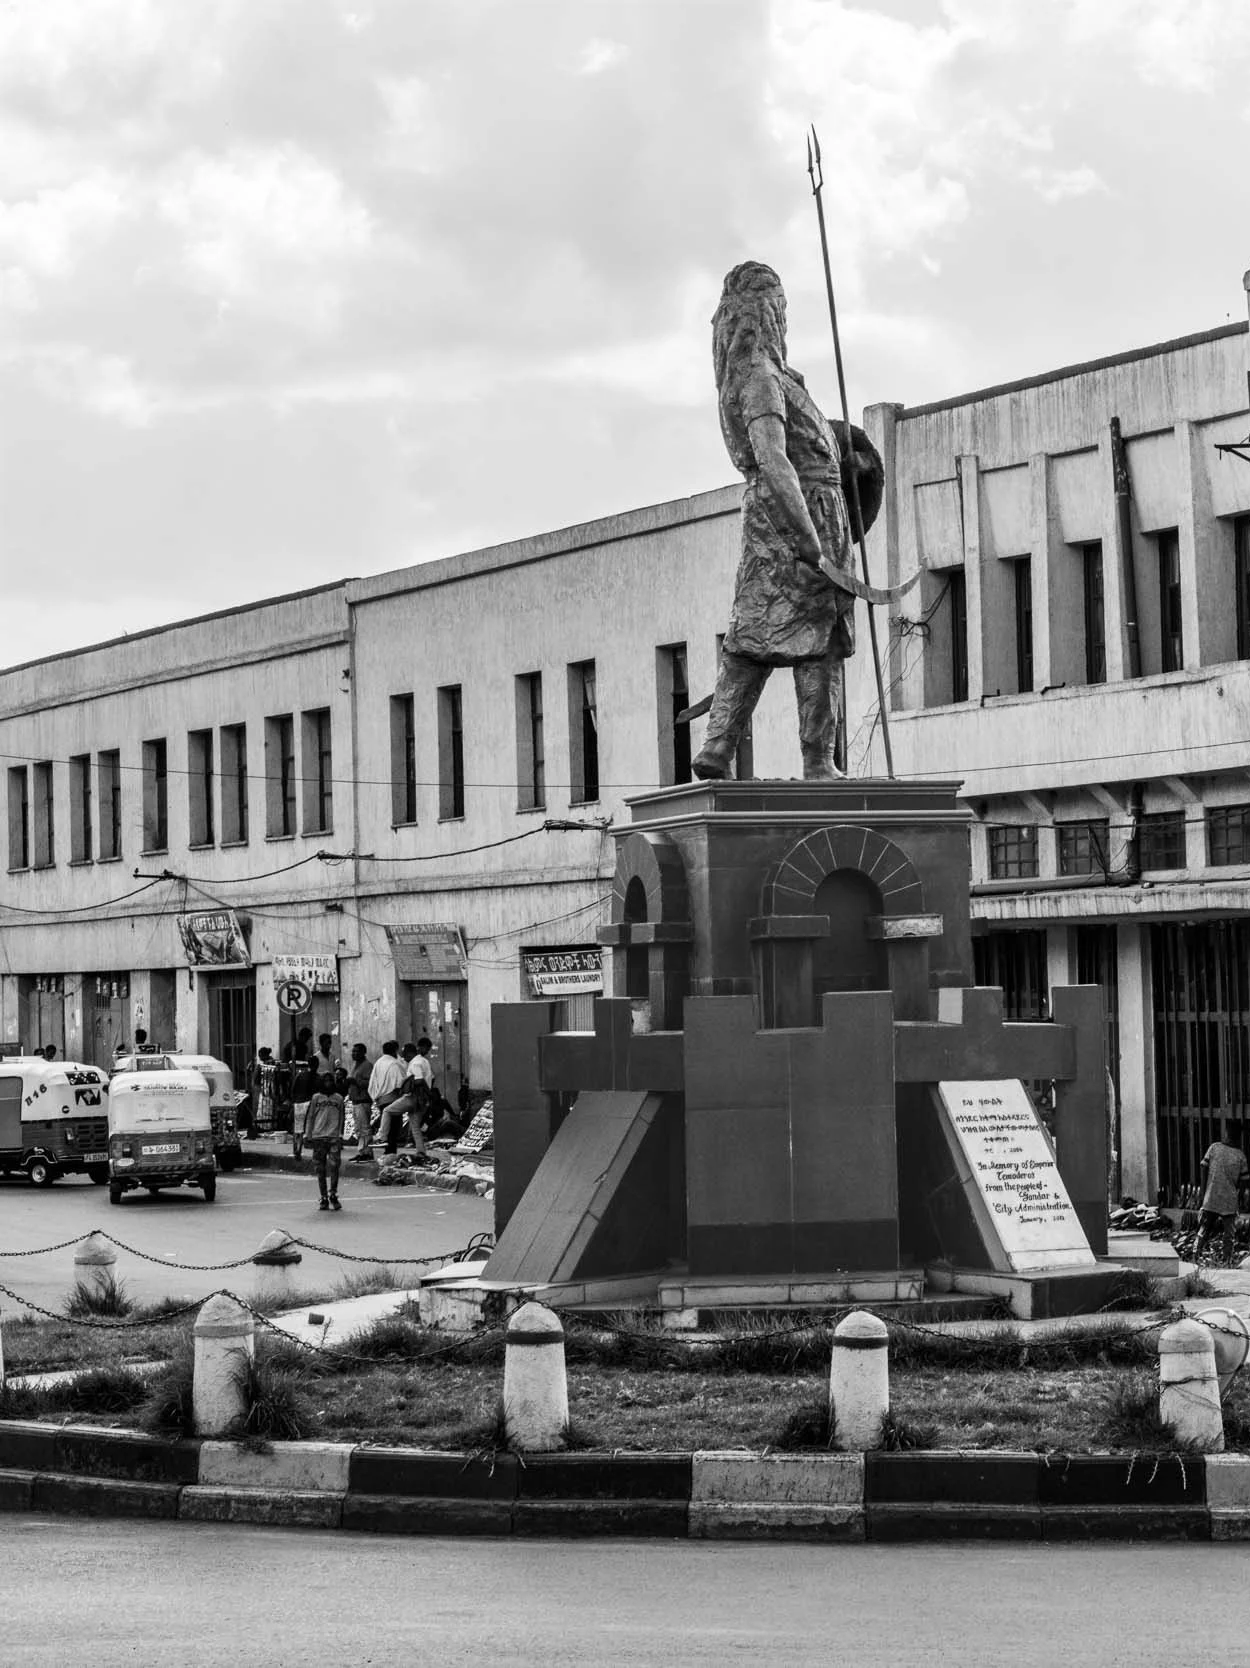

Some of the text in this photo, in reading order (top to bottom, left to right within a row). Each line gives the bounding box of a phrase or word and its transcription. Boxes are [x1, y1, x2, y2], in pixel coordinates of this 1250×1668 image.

[977, 1161, 987, 1171] In
[988, 1160, 1019, 1172] Memory
[1021, 1160, 1029, 1169] of
[985, 1183, 1004, 1192] from
[1019, 1191, 1050, 1202] Gondar
